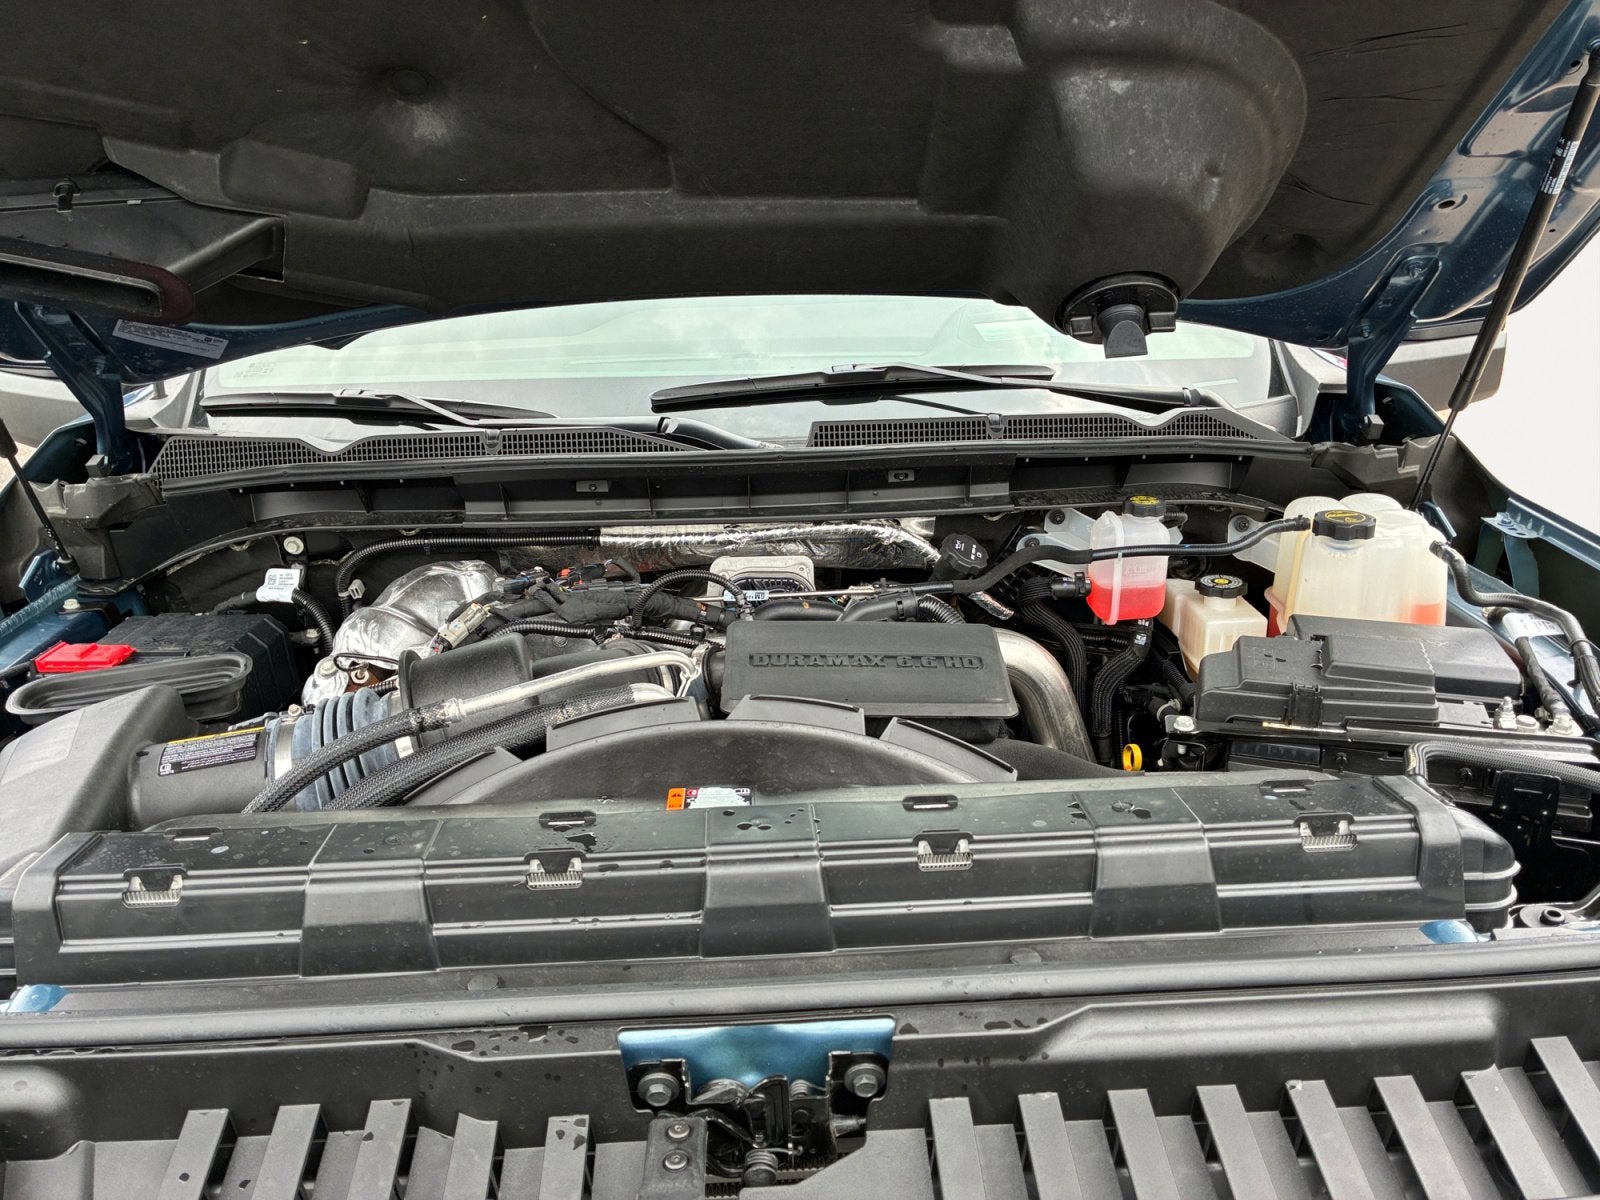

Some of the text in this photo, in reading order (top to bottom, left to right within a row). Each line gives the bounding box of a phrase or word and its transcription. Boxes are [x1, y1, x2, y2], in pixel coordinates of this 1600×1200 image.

[750, 654, 984, 669] DURAMAX 6.6 HD
